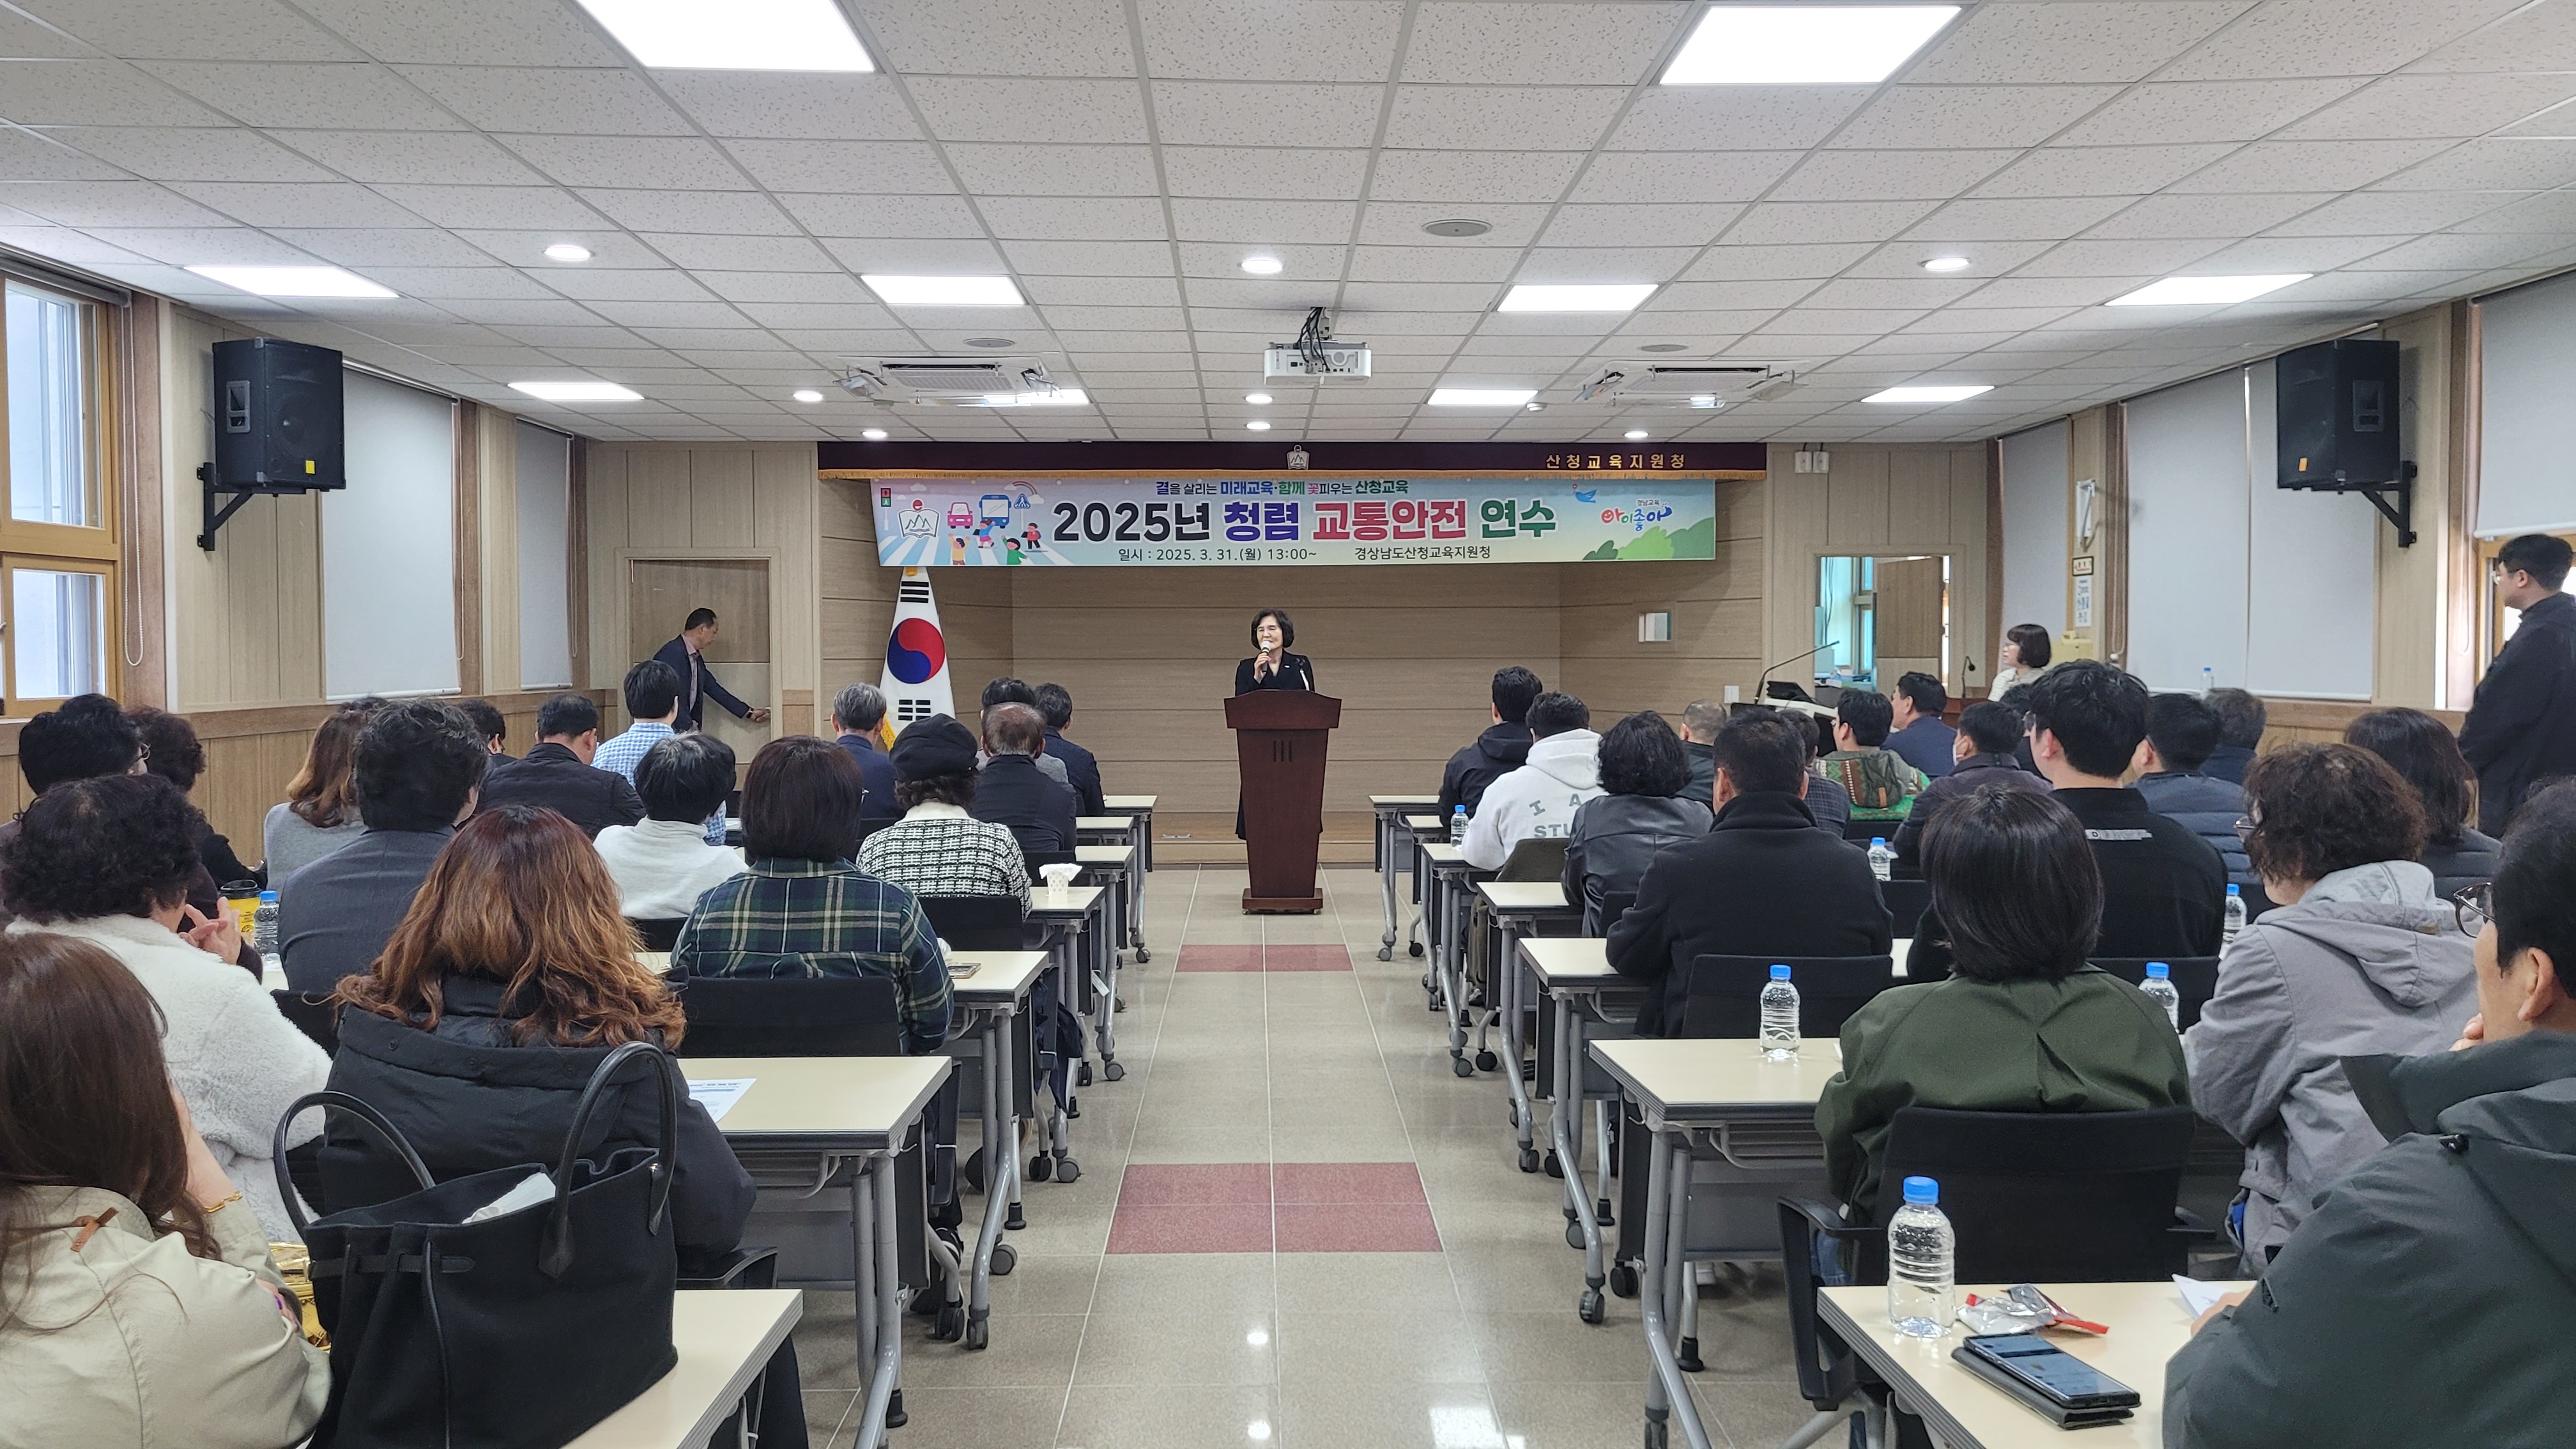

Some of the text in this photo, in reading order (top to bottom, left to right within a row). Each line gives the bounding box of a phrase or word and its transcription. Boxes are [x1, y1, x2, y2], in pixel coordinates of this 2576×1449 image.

[1546, 454, 1685, 469] 산청교육지원청
[1156, 481, 1181, 496] 결을
[1183, 482, 1218, 496] 살리는
[1308, 482, 1353, 496] 꽃피우는
[1354, 480, 1409, 494] 산청교육
[1053, 500, 1556, 542] 2025년 청렴 교통안전 연수
[1601, 506, 1673, 532] 아이좋아
[1118, 549, 1142, 562] 일시
[1156, 549, 1195, 561] 2025.
[1200, 549, 1212, 561] 3.
[1216, 548, 1262, 562] 31.(월)
[1268, 549, 1317, 561] 13:00~
[1354, 546, 1491, 562] 경상남도산청교육지원청
